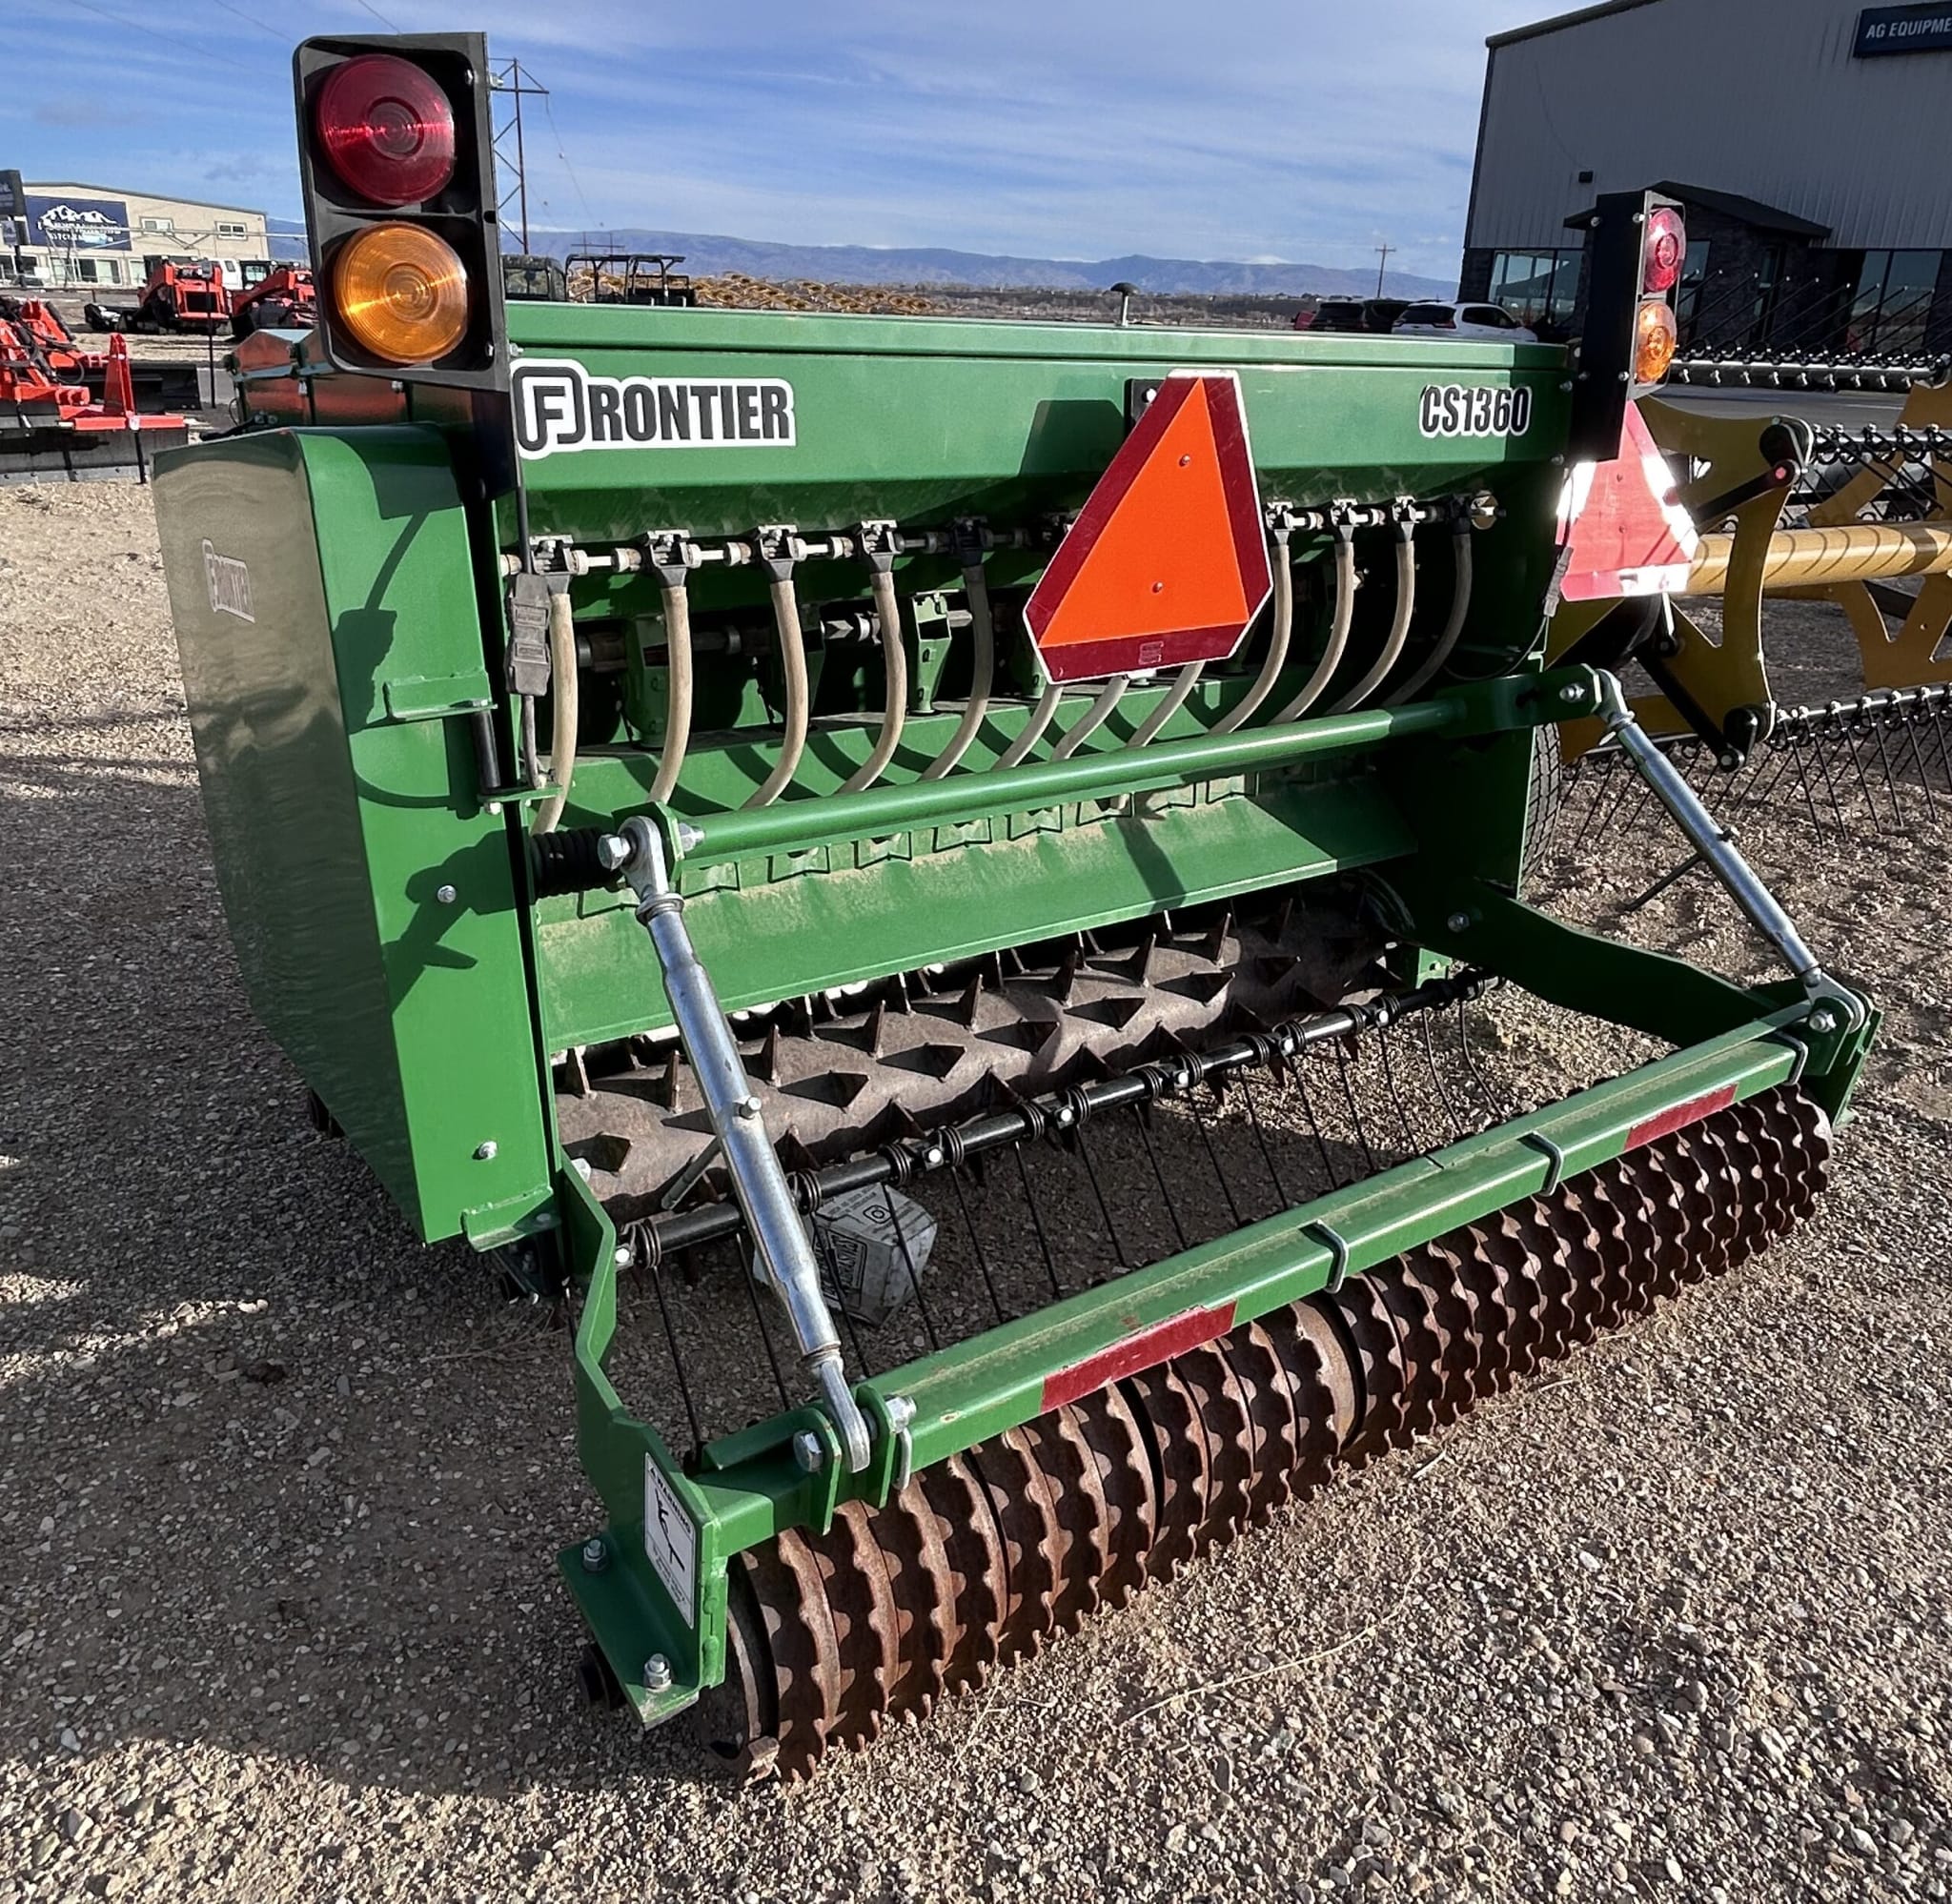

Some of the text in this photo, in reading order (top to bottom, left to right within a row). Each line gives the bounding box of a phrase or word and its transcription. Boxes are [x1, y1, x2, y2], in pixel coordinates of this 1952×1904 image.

[1865, 16, 1952, 39] AG EQUIPME
[511, 365, 790, 453] FRONTIER
[1421, 385, 1531, 434] CS1360
